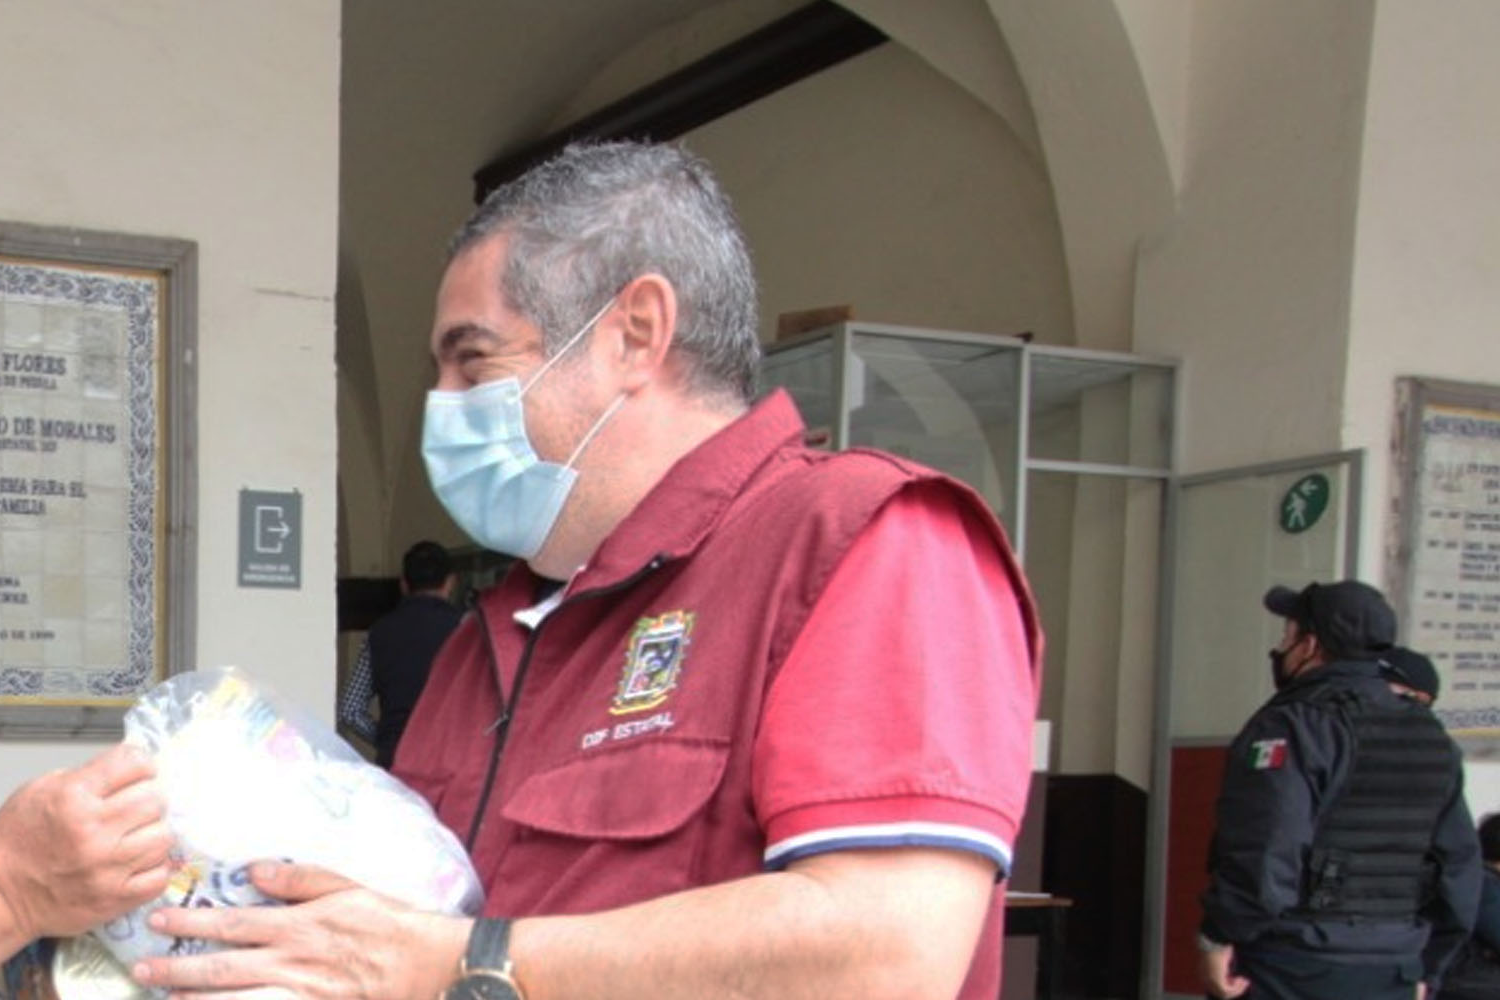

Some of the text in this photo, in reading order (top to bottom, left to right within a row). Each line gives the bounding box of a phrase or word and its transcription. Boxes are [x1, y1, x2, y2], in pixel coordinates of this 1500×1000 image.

[3, 354, 67, 376] FLORES
[13, 418, 36, 437] DE
[41, 420, 116, 444] MORALES
[32, 481, 66, 497] PARA
